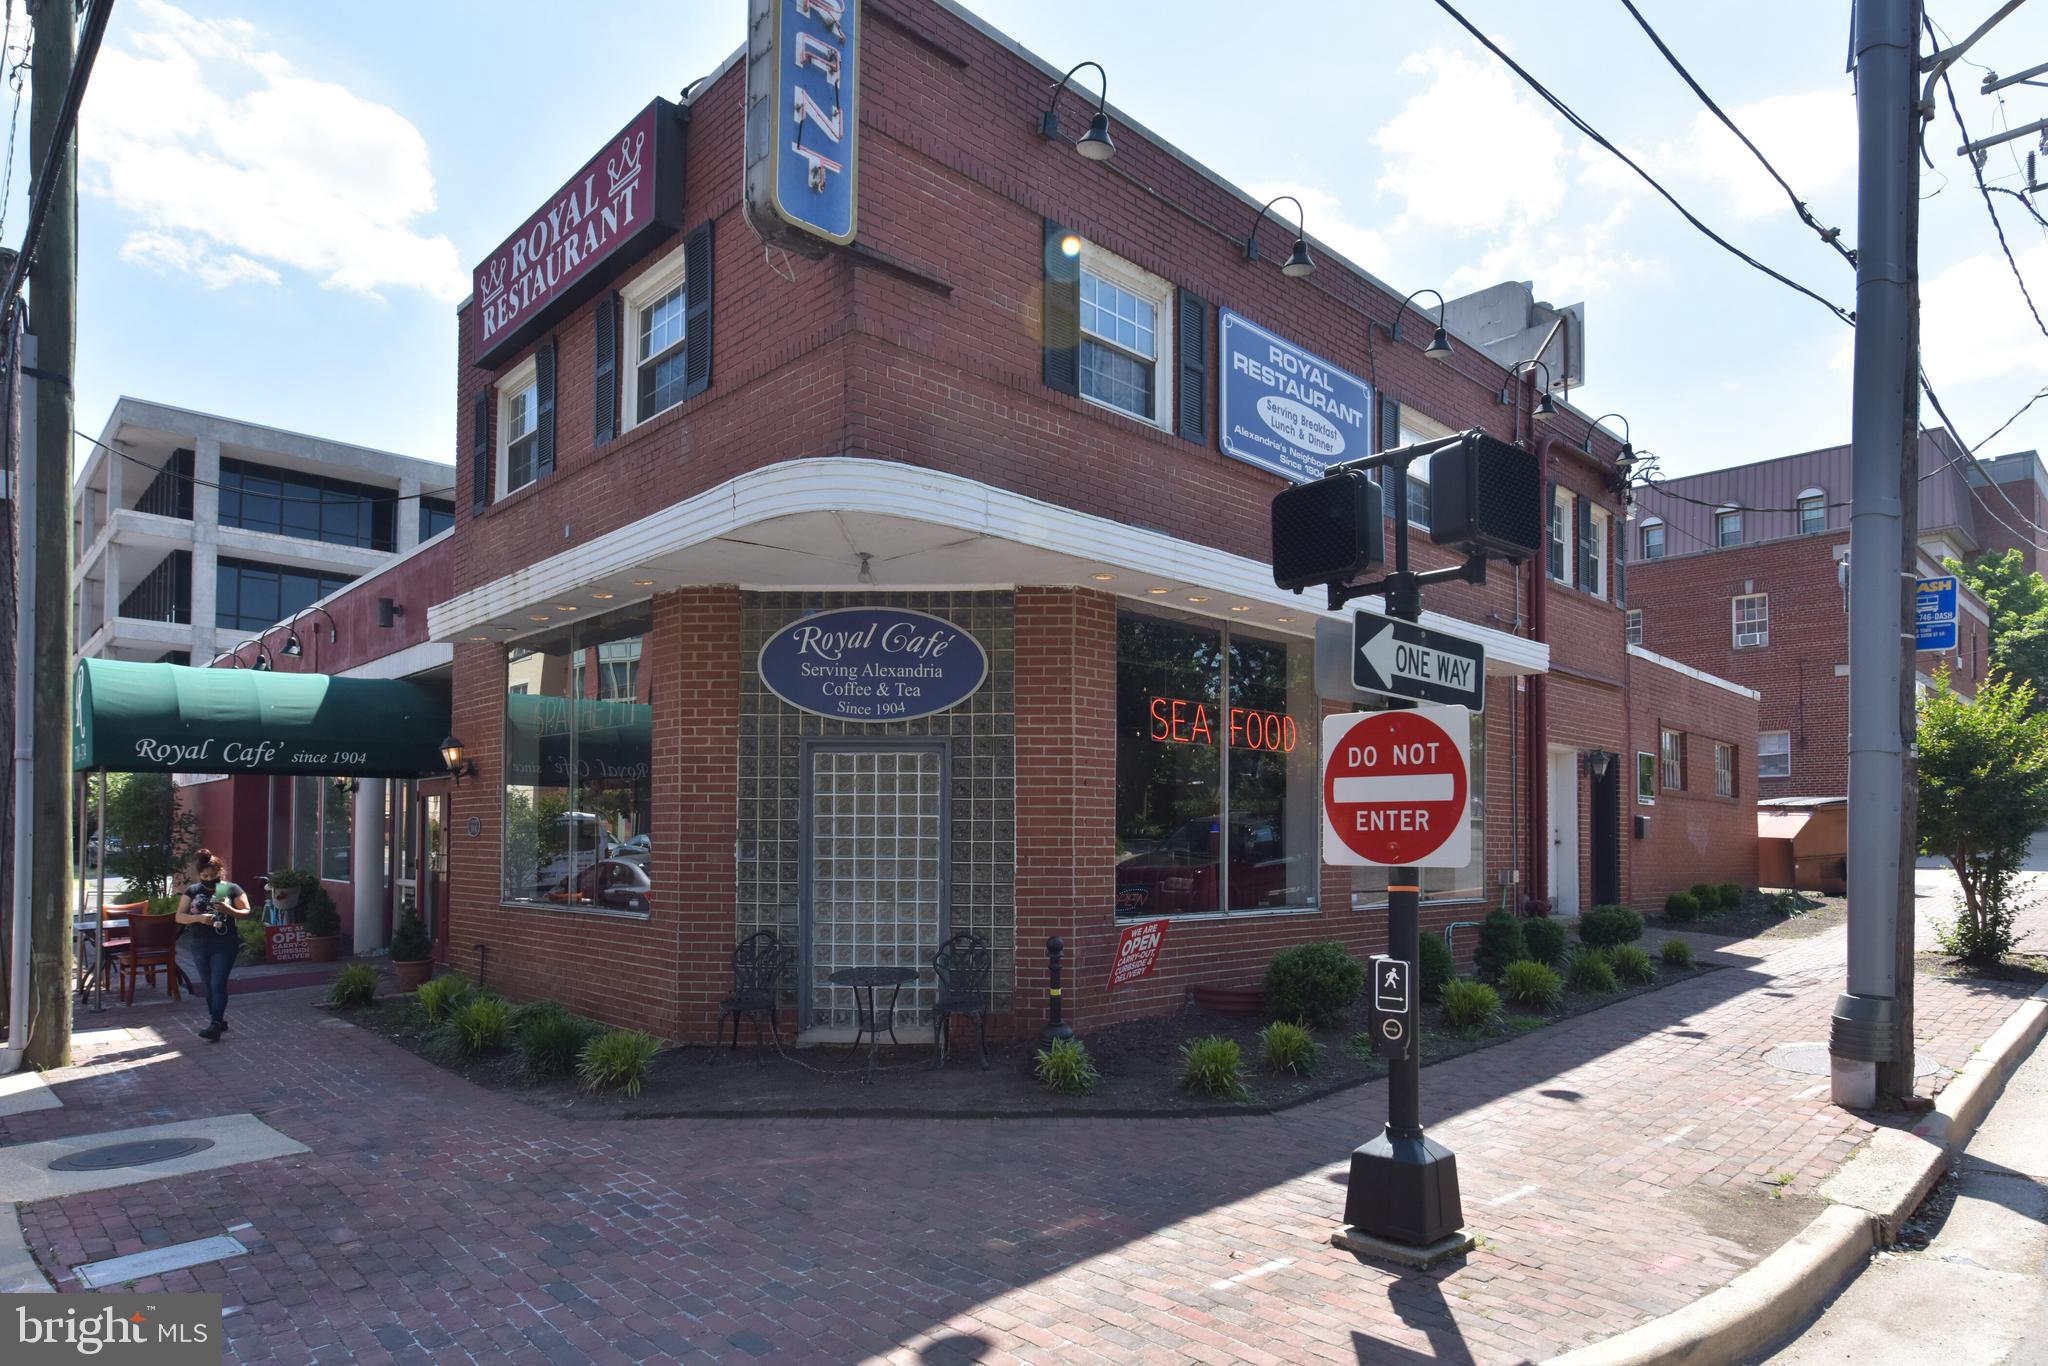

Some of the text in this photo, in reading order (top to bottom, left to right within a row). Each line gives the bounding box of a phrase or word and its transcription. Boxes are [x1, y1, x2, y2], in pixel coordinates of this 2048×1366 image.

[510, 174, 599, 280] ROYAL
[483, 178, 639, 342] RESTAURANT
[1269, 346, 1334, 393] ROYAL
[1233, 352, 1363, 428] RESTAURANT
[1266, 400, 1338, 440] Serving Breakfast
[1234, 424, 1287, 453] Alexandria's
[1271, 416, 1334, 453] Lunch & Dinner
[1280, 454, 1303, 470] Since
[1915, 580, 1953, 593] ASH
[793, 622, 956, 660] Royal Café
[801, 662, 943, 680] Serving Alexandria
[1395, 644, 1471, 687] ONE WAY
[822, 682, 921, 697] Coffee & Tea
[837, 701, 906, 715] Since 1904
[1151, 697, 1297, 752] SEA FOOD
[135, 738, 367, 768] Royal Cafe' since 1904
[1348, 743, 1440, 768] DO NOT
[1356, 810, 1430, 832] ENTER
[272, 931, 305, 943] OPE
[1131, 924, 1158, 938] WE ARE
[1121, 932, 1161, 957] OPEN
[1114, 959, 1147, 976] CURBSIDE
[1114, 966, 1147, 984] DELIVERY
